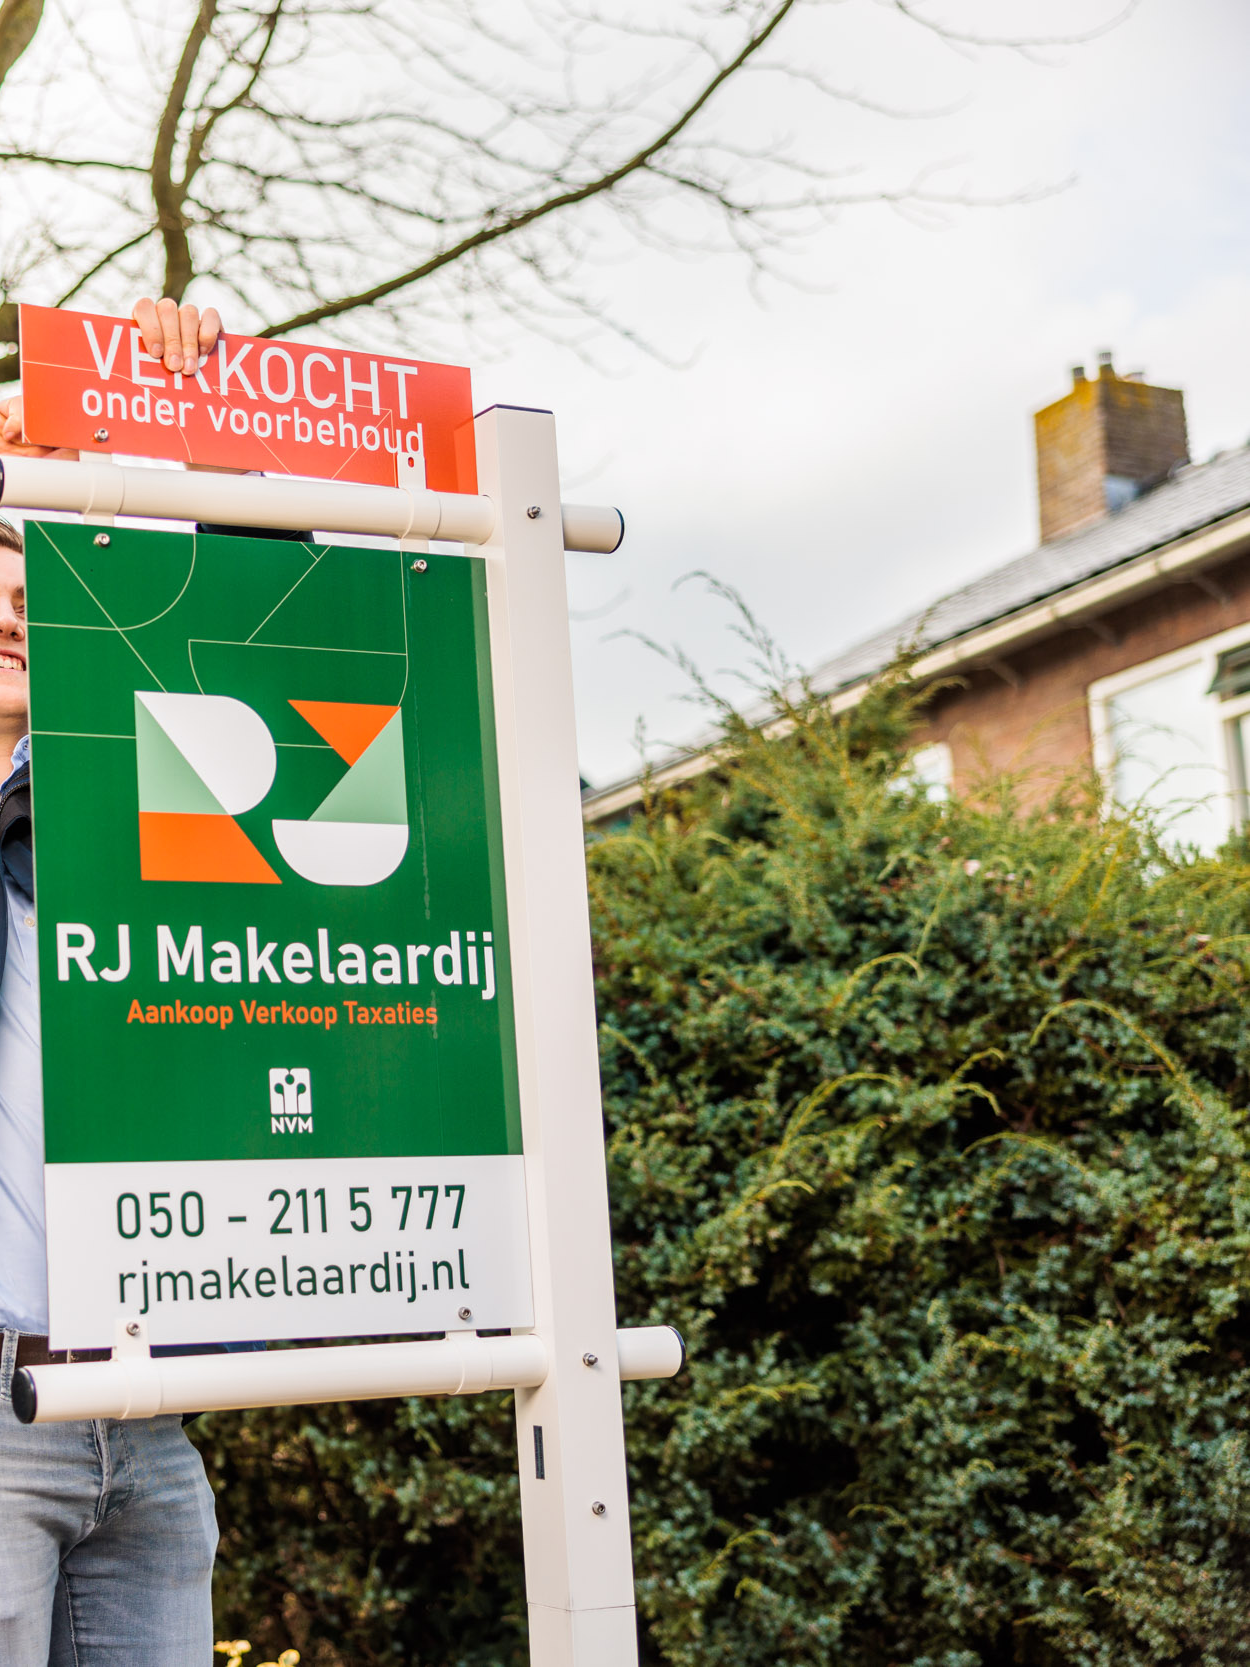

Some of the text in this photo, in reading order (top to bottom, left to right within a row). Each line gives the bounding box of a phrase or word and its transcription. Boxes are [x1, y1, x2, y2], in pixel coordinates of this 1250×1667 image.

[82, 386, 425, 455] onder voorbehoud
[56, 922, 497, 1000] RJ Makelaardij
[126, 999, 439, 1030] Aankoop Verkoop Taxaties
[270, 1116, 313, 1134] NVM
[116, 1191, 205, 1240] 050
[268, 1188, 328, 1235] 211
[349, 1186, 372, 1233] 5
[391, 1184, 466, 1231] 777
[118, 1248, 470, 1315] rjmakelaardij.nl
